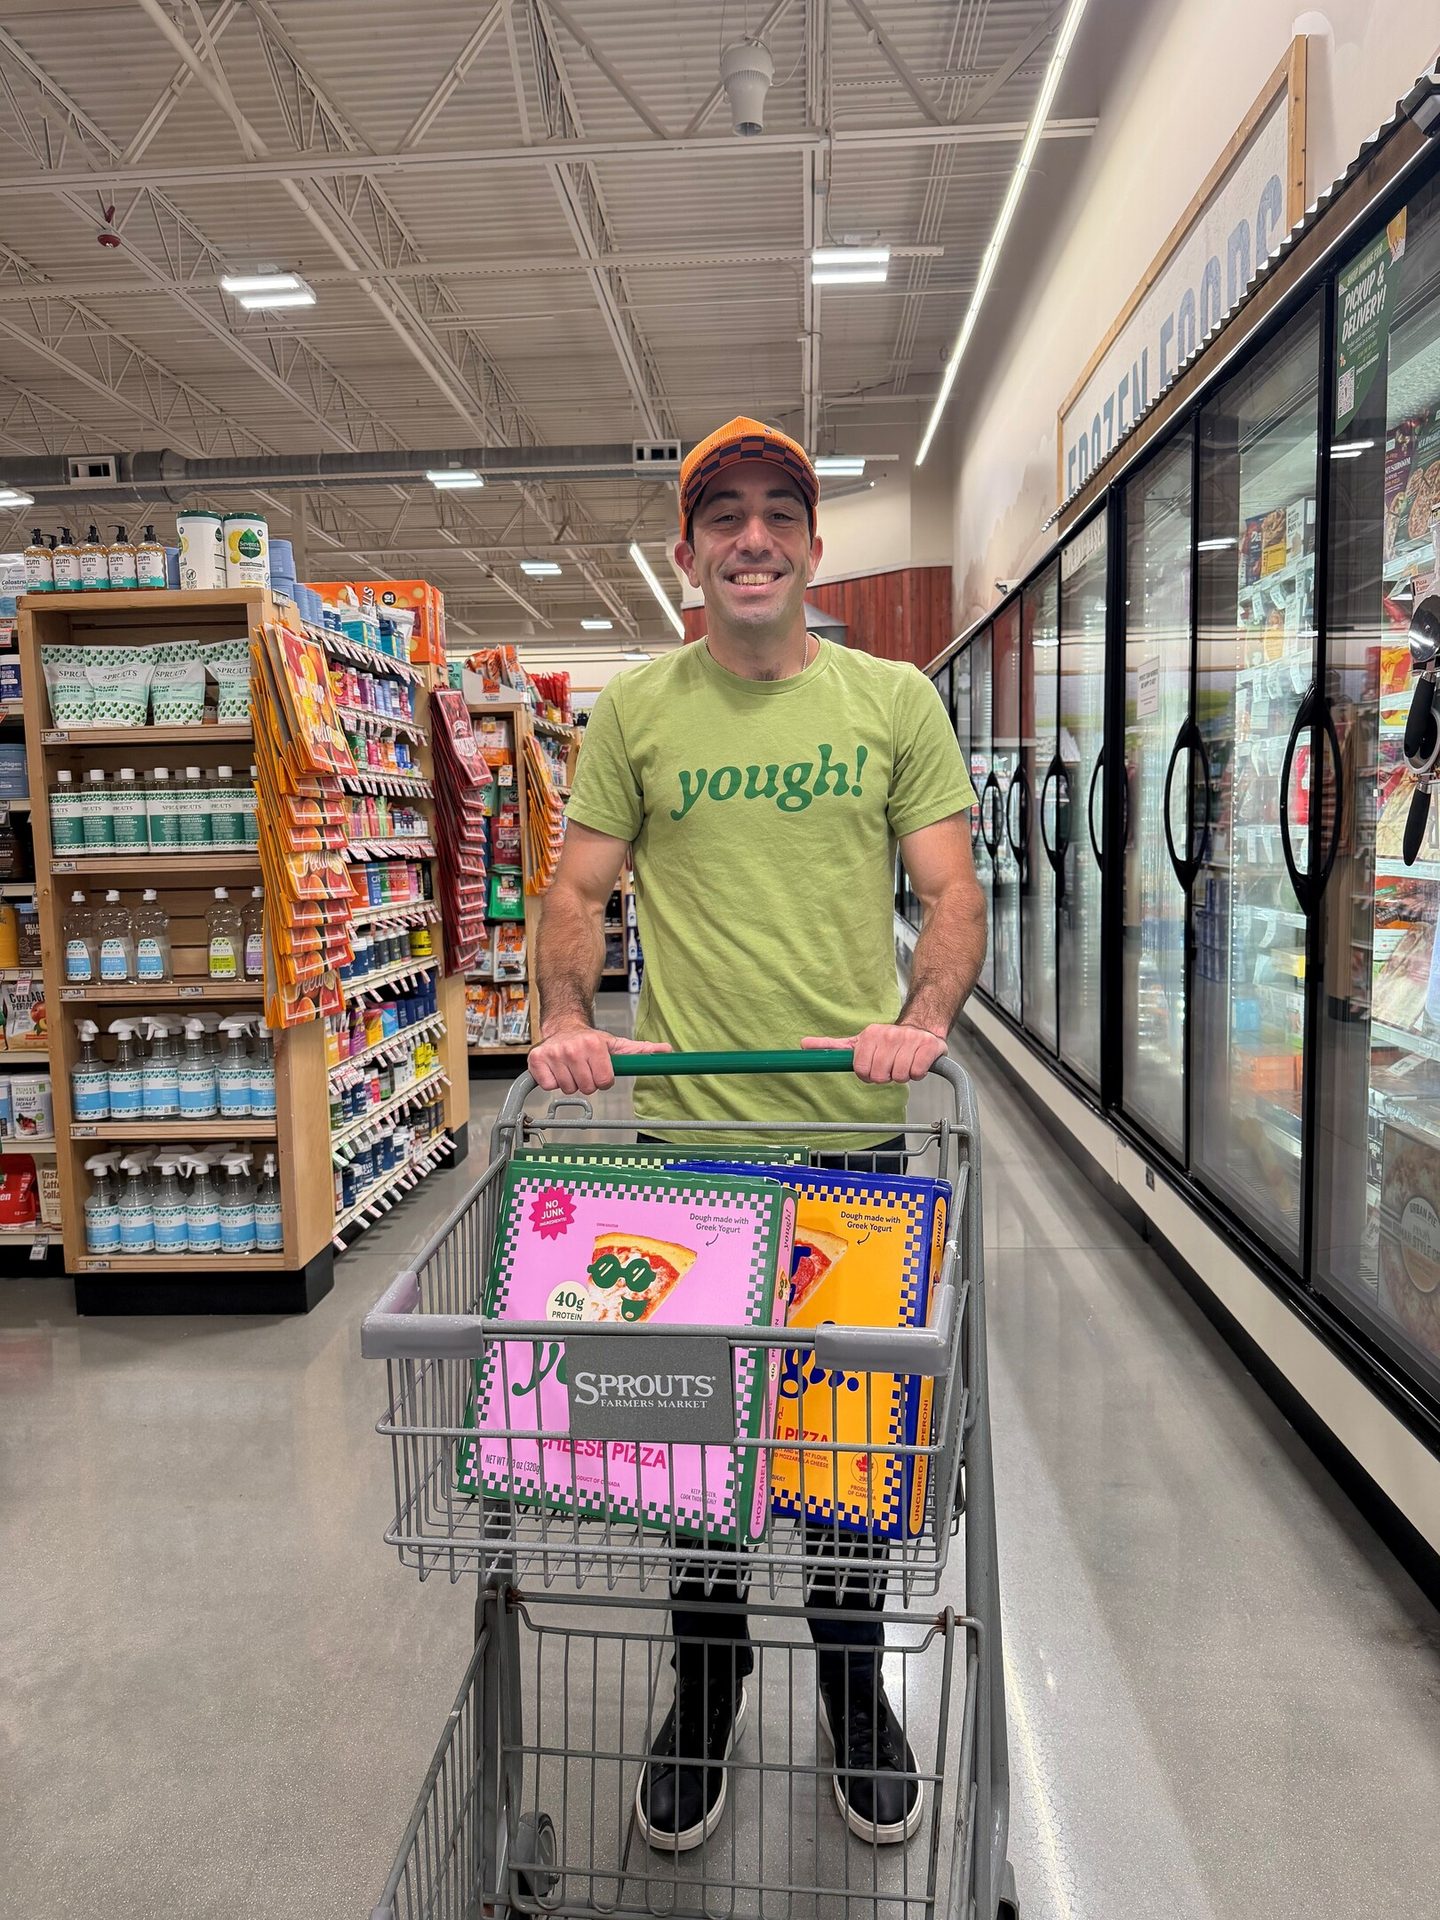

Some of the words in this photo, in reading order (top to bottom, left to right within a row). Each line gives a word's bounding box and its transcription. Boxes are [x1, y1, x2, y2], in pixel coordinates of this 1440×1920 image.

[1343, 269, 1376, 318] PICKUP
[1376, 260, 1386, 287] &
[1341, 284, 1388, 344] DELIVERY!
[102, 670, 138, 681] SPROUTS
[155, 668, 187, 679] SPROUTS
[671, 744, 869, 821] yough!
[545, 1199, 559, 1209] NO
[541, 1208, 565, 1220] JUNK
[689, 1212, 713, 1223] Dough
[713, 1214, 733, 1225] made
[733, 1215, 749, 1225] with
[840, 1211, 864, 1223] Dough
[864, 1213, 883, 1223] made
[883, 1214, 901, 1224] with
[695, 1222, 718, 1232] Greek
[718, 1223, 741, 1234] Yogurt
[783, 1208, 792, 1252] yough!
[846, 1220, 869, 1231] Greek
[869, 1222, 893, 1233] Yogurt
[935, 1208, 944, 1252] yough!
[554, 1291, 585, 1312] 40g
[551, 1311, 583, 1321] PROTEIN
[574, 1371, 714, 1405] SPROUTS
[600, 1399, 654, 1408] FARMERS
[657, 1400, 708, 1409] MARKET
[485, 1454, 497, 1465] NET
[496, 1456, 506, 1466] WT
[516, 1460, 524, 1469] oz
[612, 1442, 667, 1469] PIZZA
[811, 1452, 829, 1462] FLOUR,
[810, 1460, 829, 1469] CHEESE
[847, 1489, 856, 1497] OF
[850, 1484, 875, 1493] PRODUT
[914, 1465, 924, 1522] UNCURED
